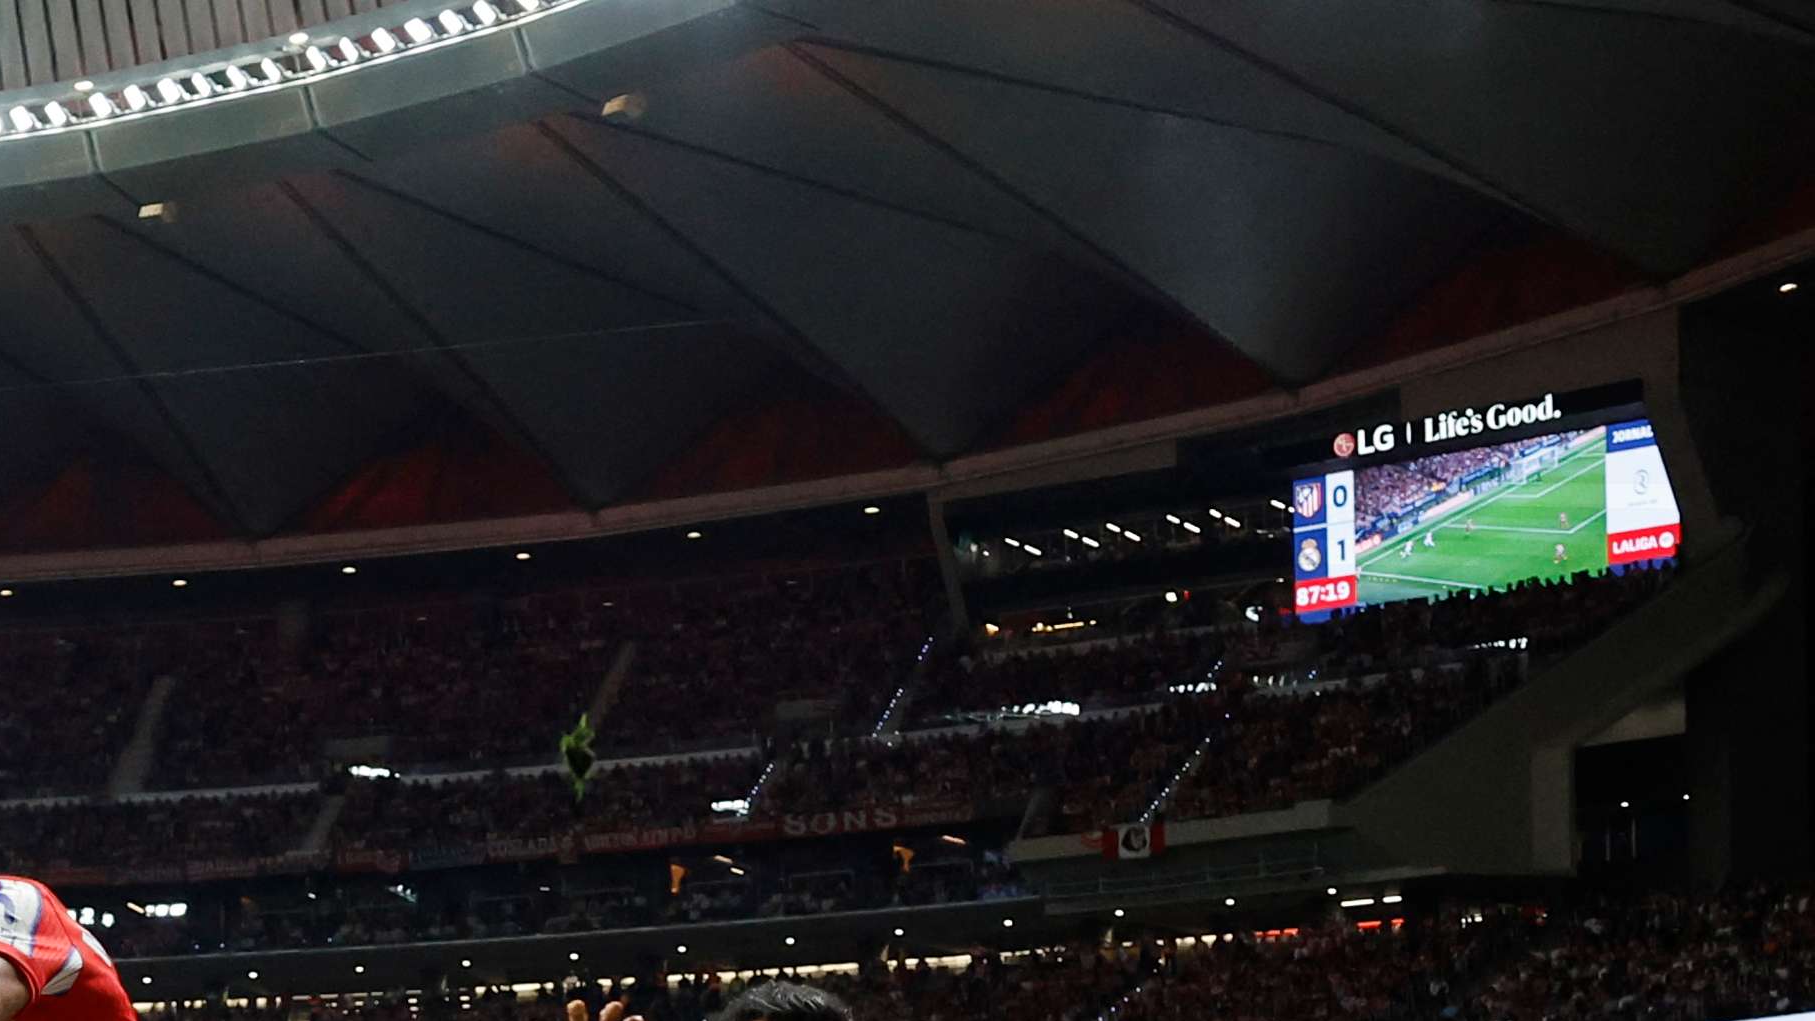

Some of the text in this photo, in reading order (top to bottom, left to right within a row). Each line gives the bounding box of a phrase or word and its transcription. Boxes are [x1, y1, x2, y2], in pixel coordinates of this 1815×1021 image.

[1424, 393, 1562, 443] Life's Good.
[1356, 425, 1395, 456] LG
[1333, 485, 1348, 507] 0
[1337, 539, 1346, 561] 1
[1611, 535, 1659, 555] LALIGA
[1295, 580, 1351, 606] 87:19
